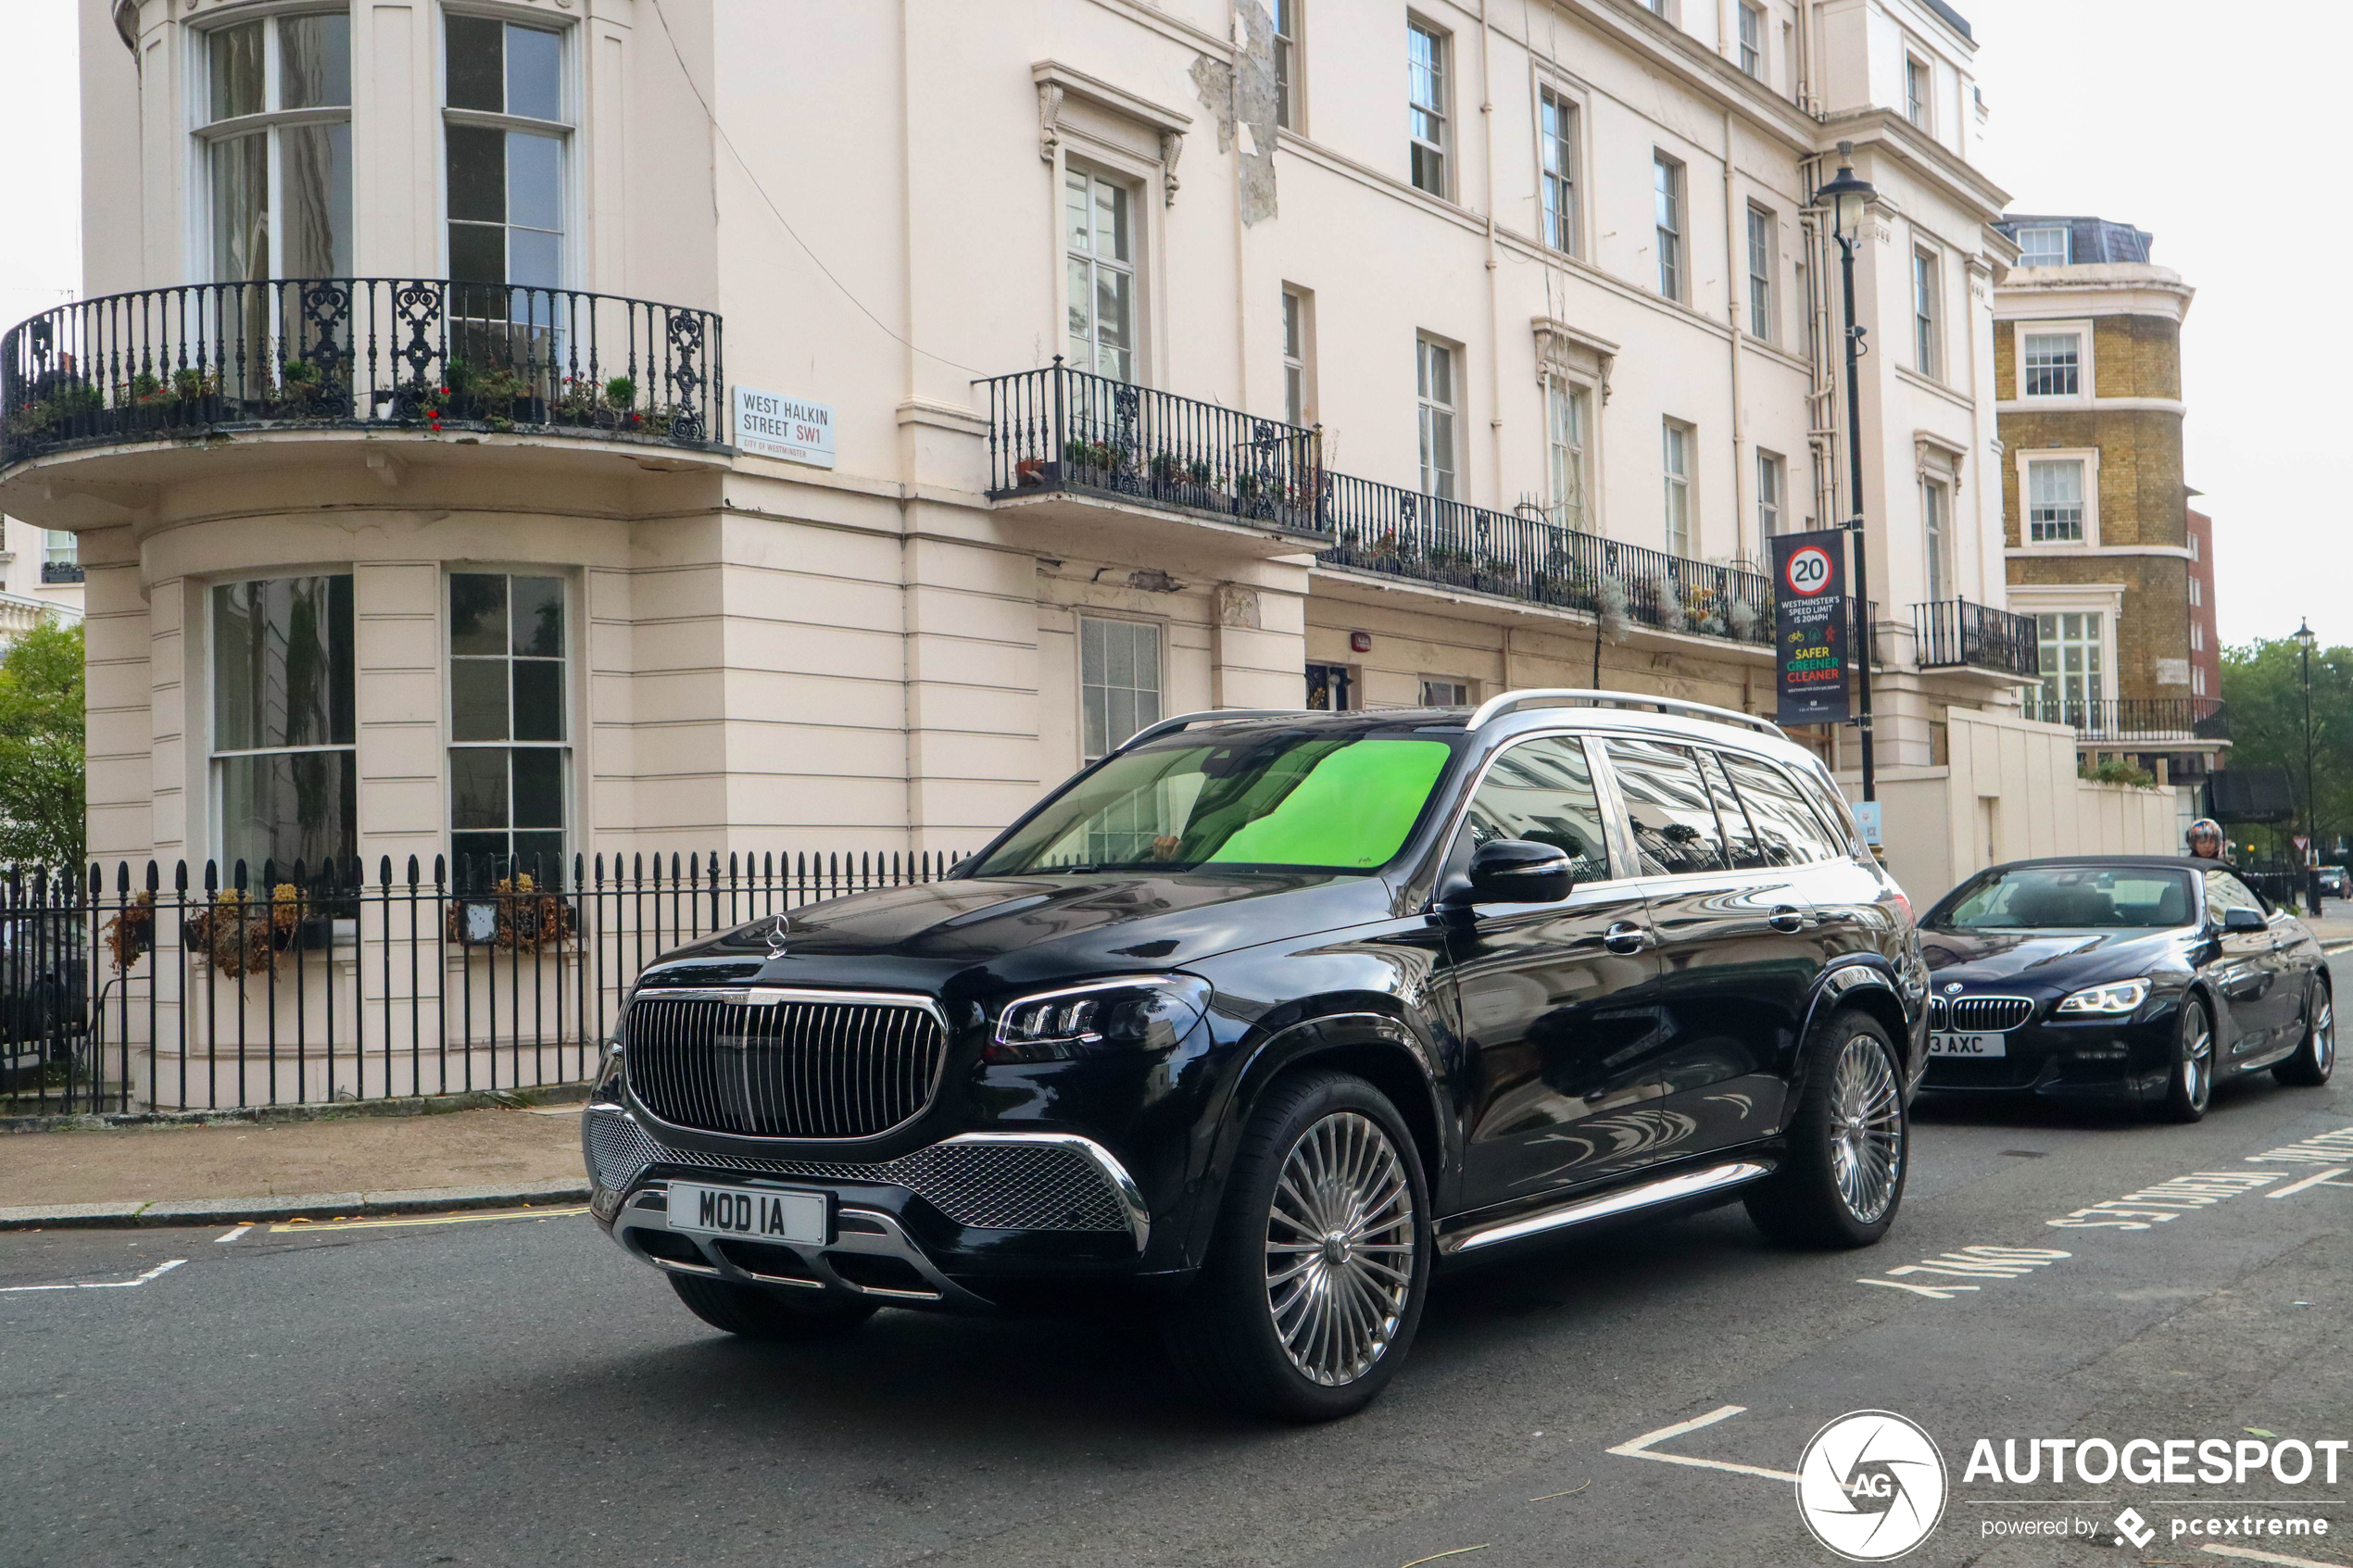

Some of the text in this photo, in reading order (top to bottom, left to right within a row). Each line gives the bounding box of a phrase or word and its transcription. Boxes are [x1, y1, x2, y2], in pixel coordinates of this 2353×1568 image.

[743, 393, 827, 425] WEST HALKIN
[744, 414, 820, 444] STREET SW1
[744, 439, 806, 458] CITY OF WESTMINSTER
[1794, 558, 1824, 583] 20
[1781, 596, 1840, 608] WESTMINSTER'S
[1789, 605, 1832, 616] SPEED LIMIT
[1802, 613, 1829, 622] 20MPH
[1795, 646, 1830, 659] SAFER
[1787, 658, 1839, 671] GREENER
[1787, 669, 1839, 683] CLEANER
[1947, 1036, 1983, 1053] AXC
[2046, 1172, 2289, 1230] VEHICLES
[699, 1190, 751, 1232] MOD
[1856, 1246, 2072, 1298] ONLY
